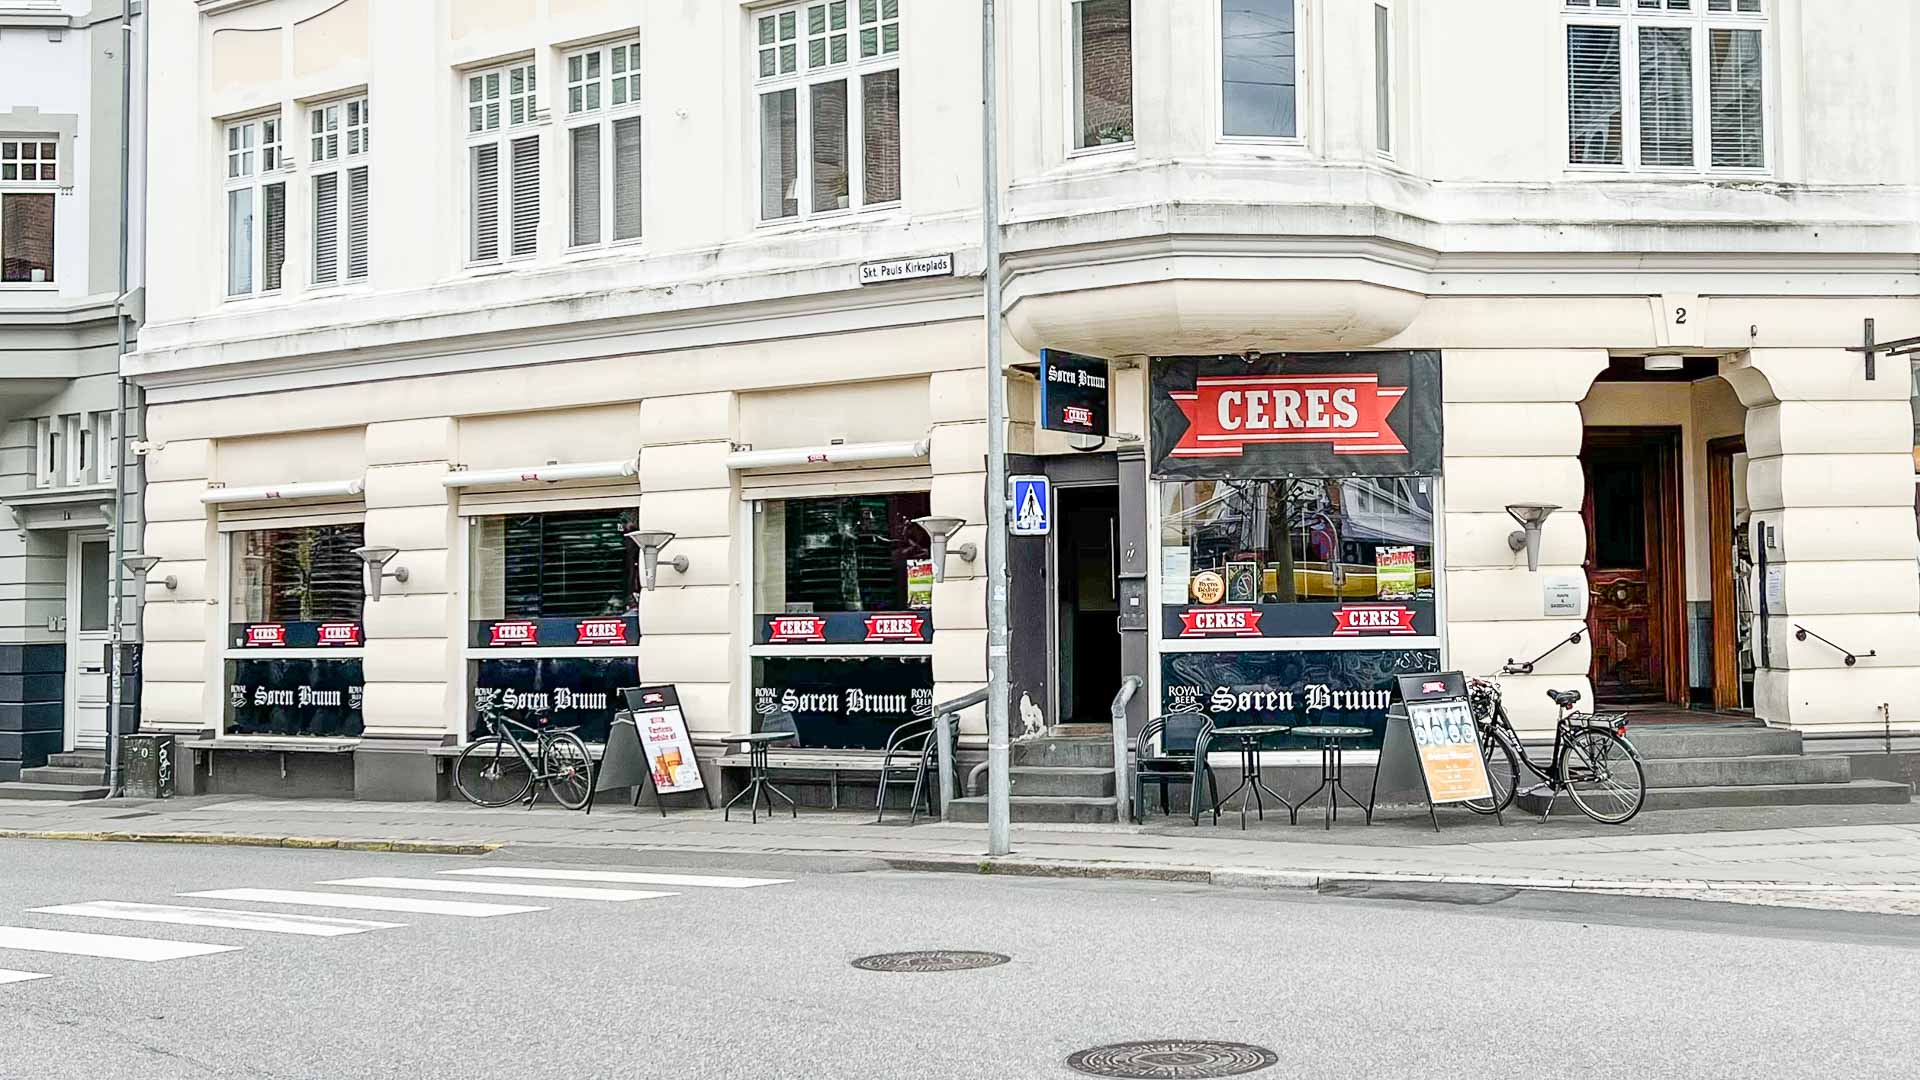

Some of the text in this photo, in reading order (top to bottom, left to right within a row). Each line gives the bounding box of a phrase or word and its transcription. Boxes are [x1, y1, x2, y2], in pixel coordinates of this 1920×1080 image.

[881, 264, 903, 276] Pauls
[905, 260, 948, 274] Kirkeplads
[1675, 307, 1687, 324] 2
[1047, 364, 1076, 384] Søren
[1068, 409, 1088, 420] CERES
[1217, 387, 1359, 431] CERES
[1195, 612, 1246, 629] CERES
[1348, 610, 1400, 626] CERES
[253, 628, 278, 640] CERES
[325, 627, 351, 639] CERES
[498, 625, 528, 639] CERES
[586, 623, 617, 637] CERES
[780, 620, 815, 635] CERES
[876, 619, 913, 634] CERES
[254, 685, 342, 708] Søren Bruun
[755, 687, 778, 697] ROYAL
[911, 688, 934, 698] ROYA
[1168, 685, 1204, 697] ROYAL
[1210, 685, 1294, 713] Søren
[1304, 683, 1392, 714] Bruun
[502, 687, 608, 712] Søren Bruun
[781, 687, 907, 715] Søren Bruun
[1175, 695, 1197, 704] BEER
